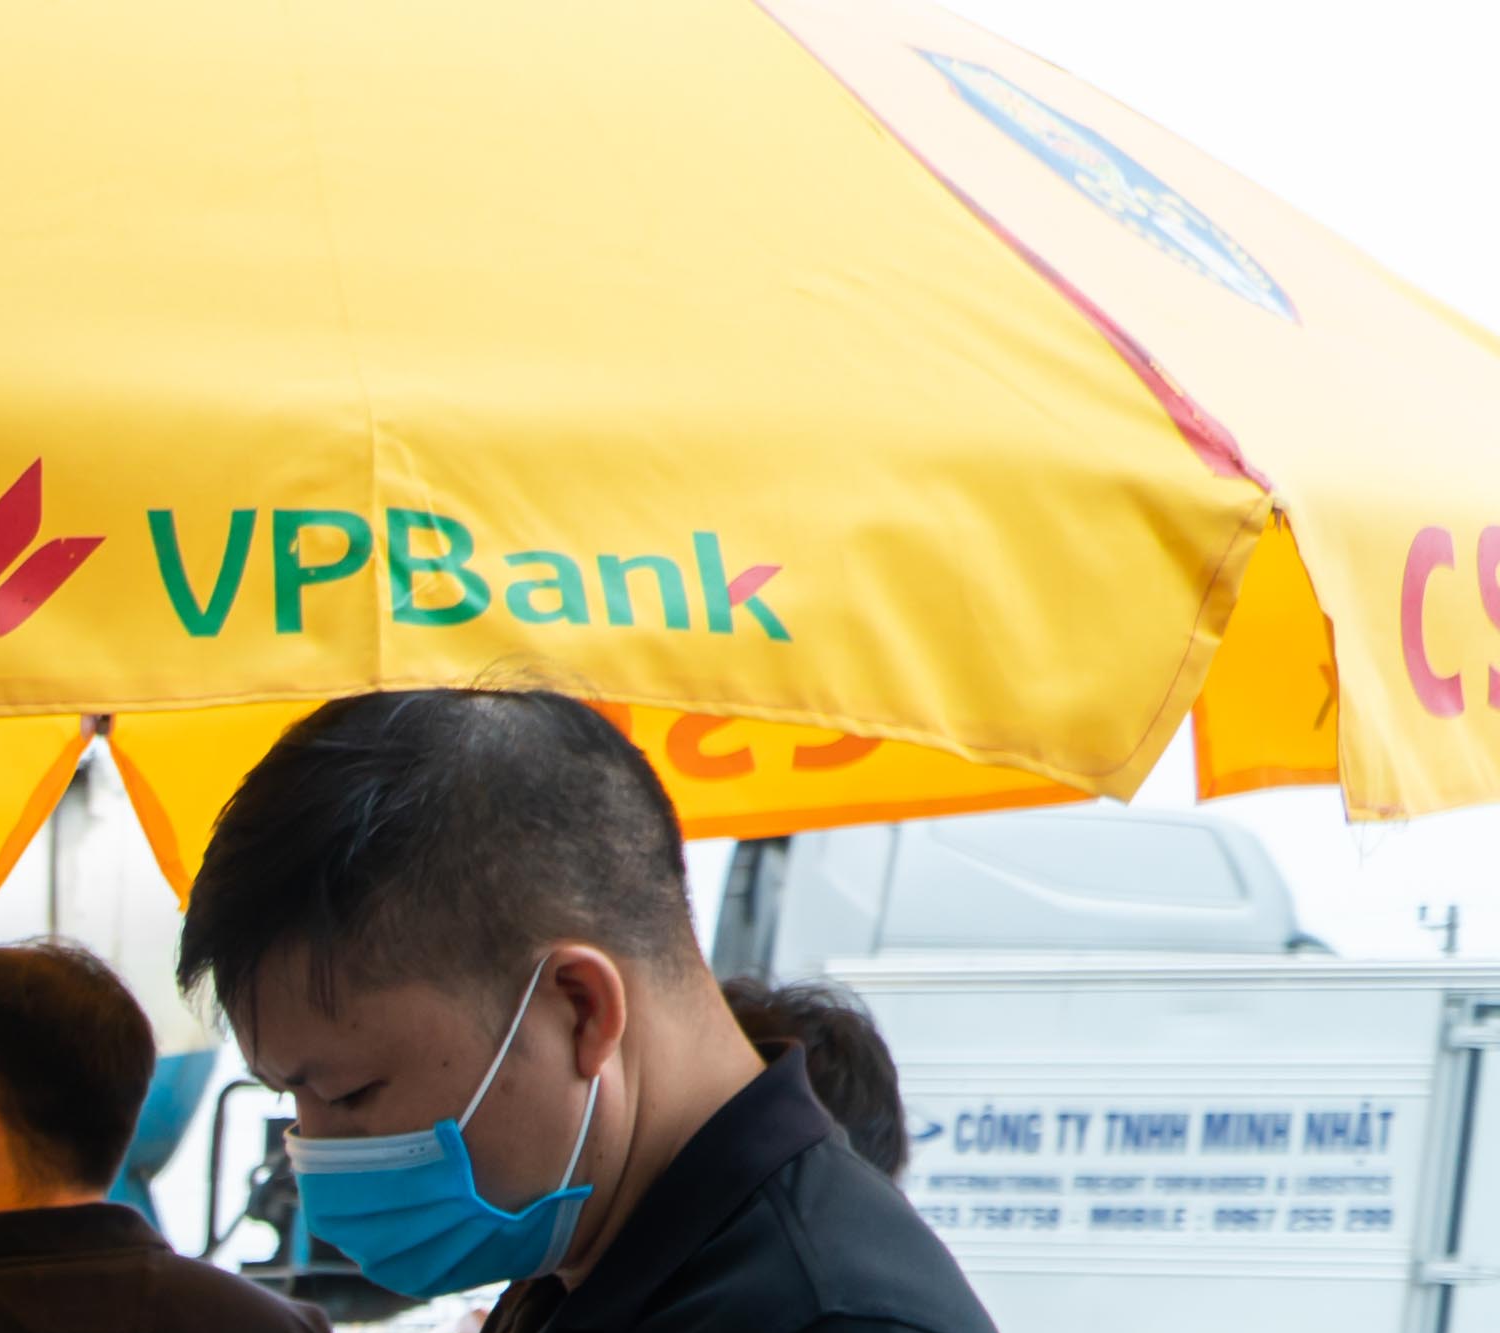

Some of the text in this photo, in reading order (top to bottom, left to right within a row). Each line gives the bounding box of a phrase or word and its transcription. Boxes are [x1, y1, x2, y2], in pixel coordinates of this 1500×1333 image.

[146, 506, 793, 643] VPBank
[954, 1101, 1394, 1166] CÔNG TY TNHH MINH NHẬT
